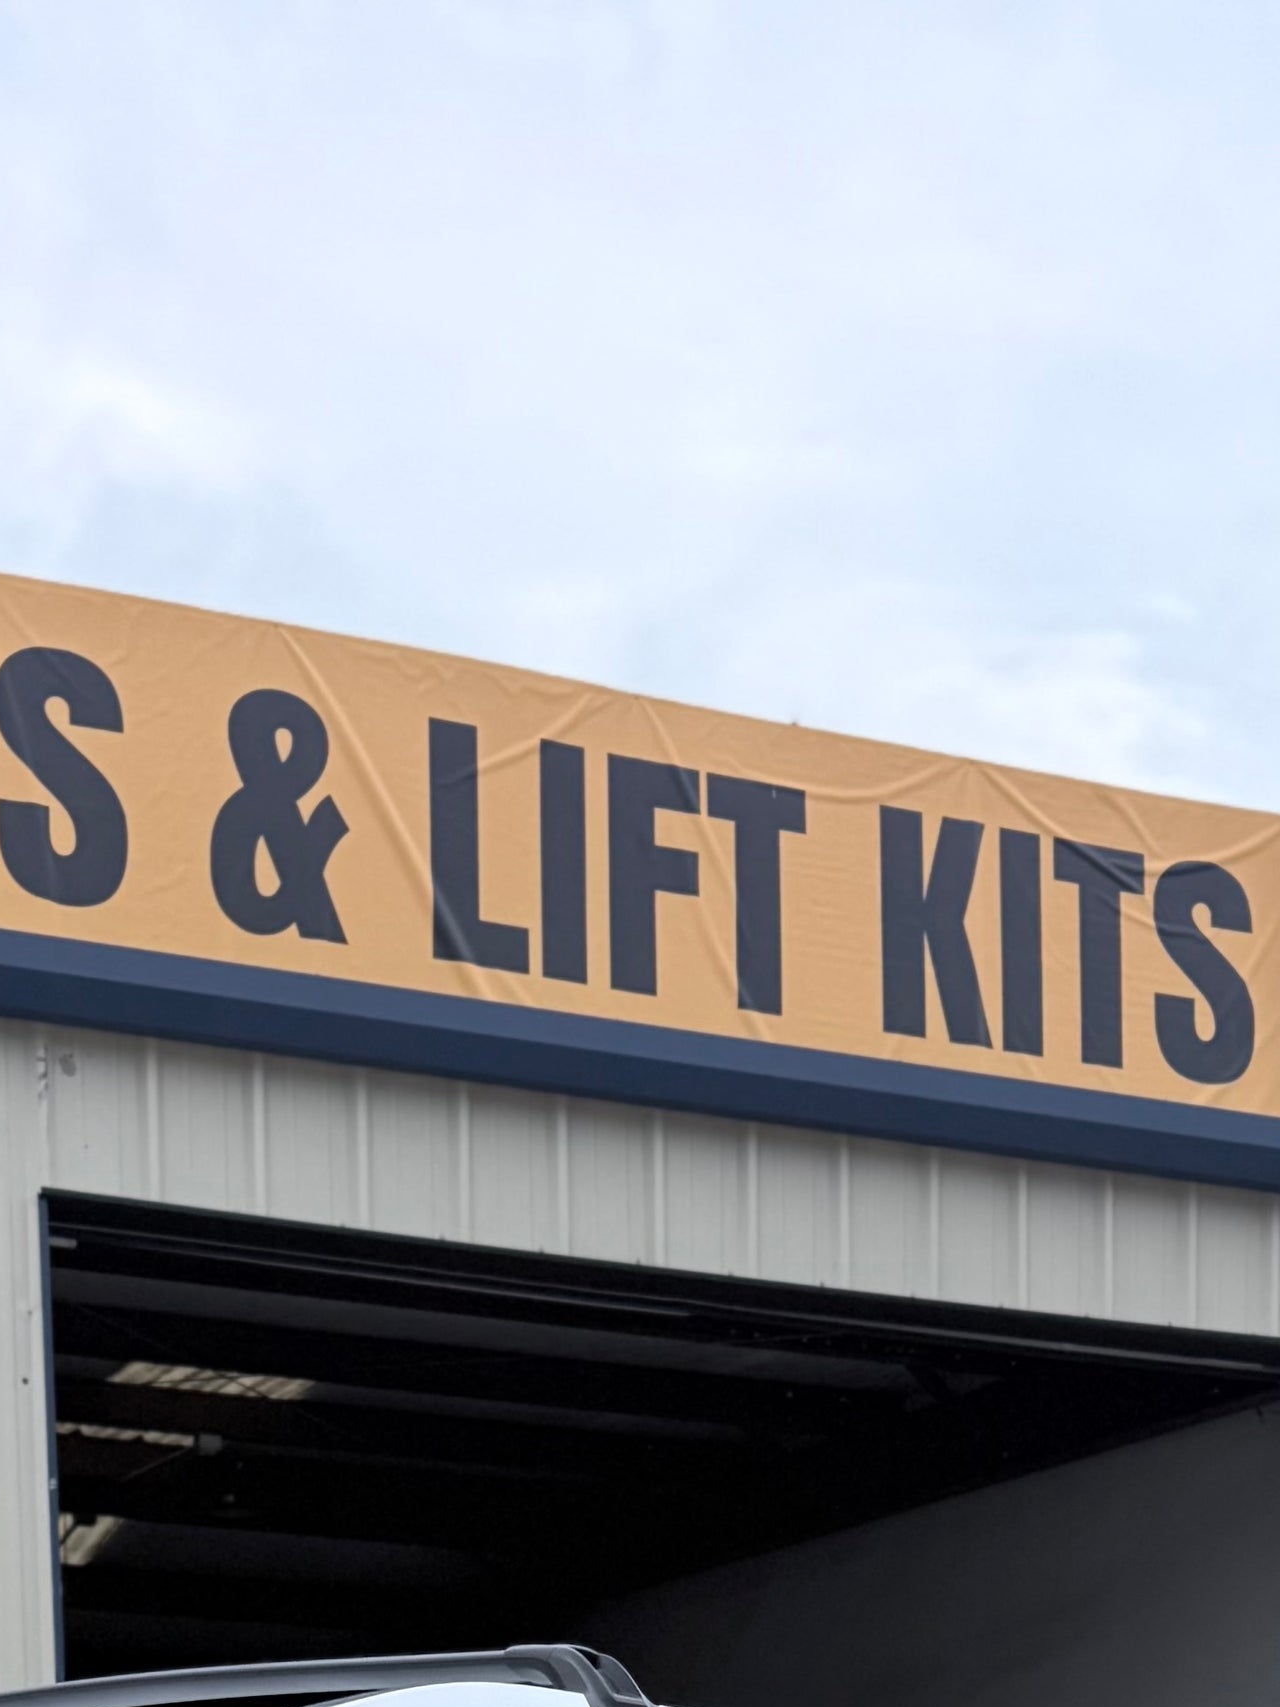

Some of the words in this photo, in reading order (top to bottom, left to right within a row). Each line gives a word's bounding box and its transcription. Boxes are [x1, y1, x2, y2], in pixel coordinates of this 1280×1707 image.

[210, 689, 349, 944] &
[429, 717, 806, 1016] LIFT
[880, 805, 1254, 1084] KITS
